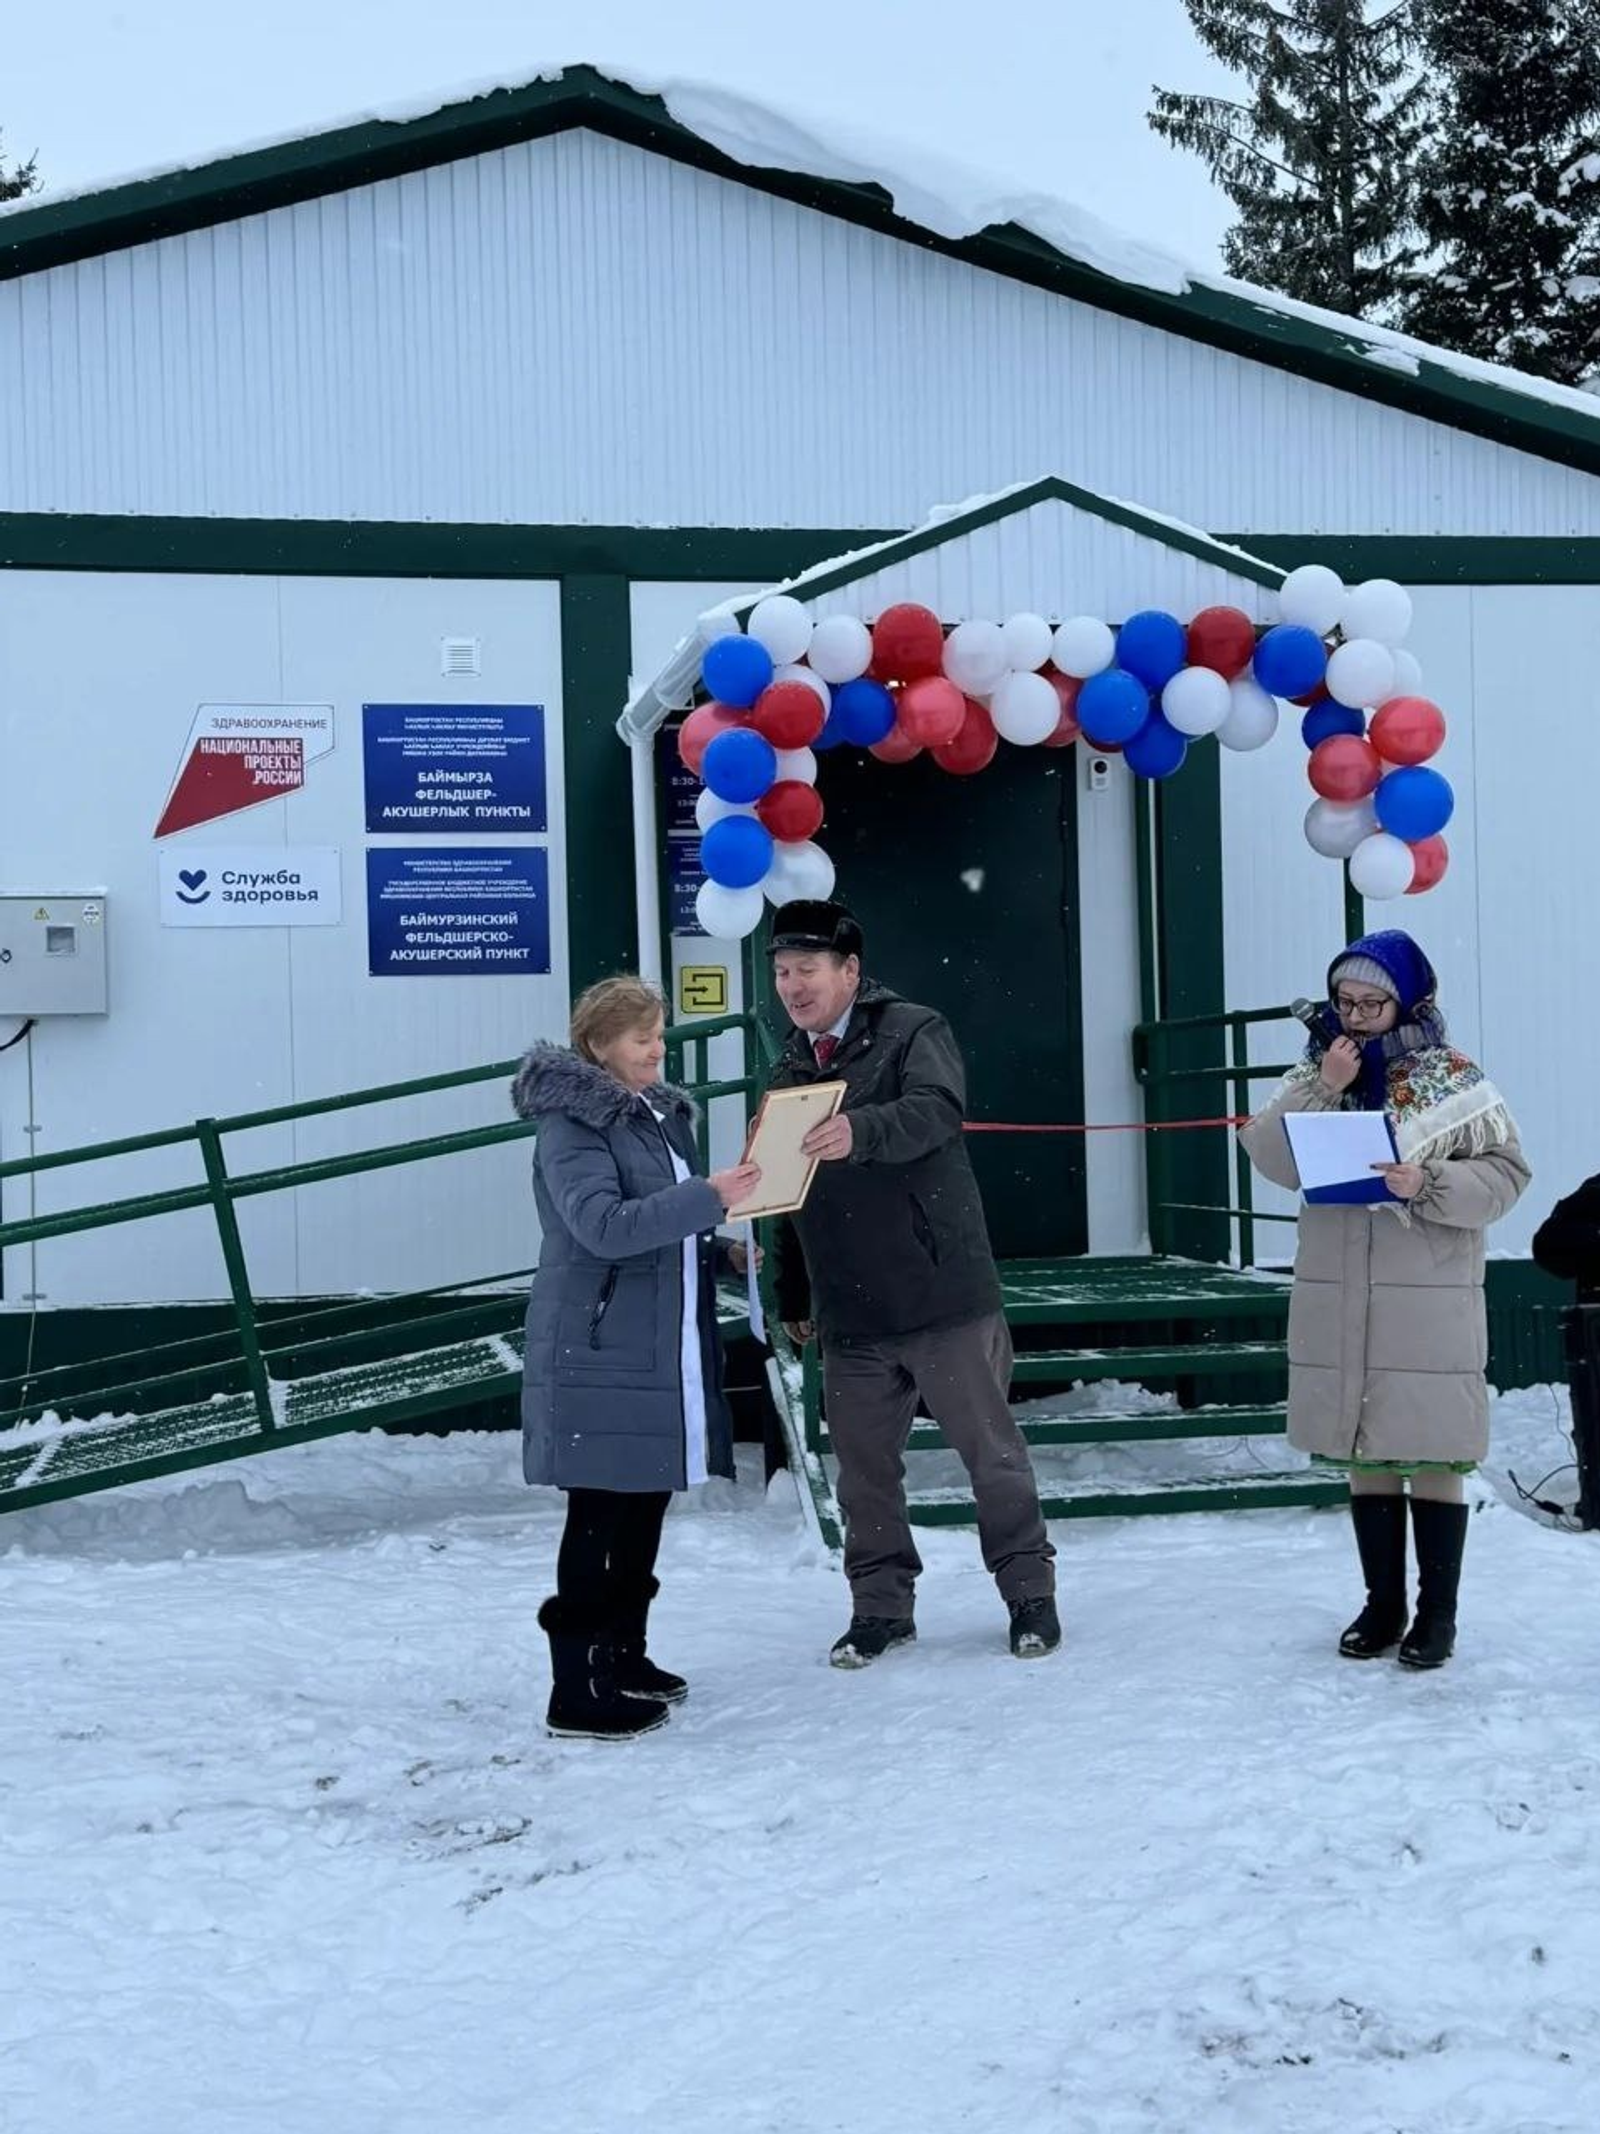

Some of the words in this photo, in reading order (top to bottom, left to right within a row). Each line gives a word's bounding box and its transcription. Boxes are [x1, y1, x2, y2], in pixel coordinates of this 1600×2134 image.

[212, 718, 327, 730] ЗДРАВООХРАНЕНИЕ
[200, 739, 301, 754] НАЦИОНАЛЬНЫЕ
[244, 755, 301, 769] ПРОЕКТЫ
[254, 770, 301, 785] РОССИИ
[415, 789, 497, 801] ФЕЛЬДШЕР-
[475, 806, 531, 817] ПУНКТЫ
[221, 870, 301, 887] Служба
[221, 890, 319, 905] здоровья
[400, 911, 519, 926] БАЙМУРЗИНСКИЙ
[405, 931, 514, 944] ФЕЛЬДШЕРСКО-
[389, 946, 482, 961] АКУШЕРСКИЙ
[485, 948, 530, 960] ПУНКТ
